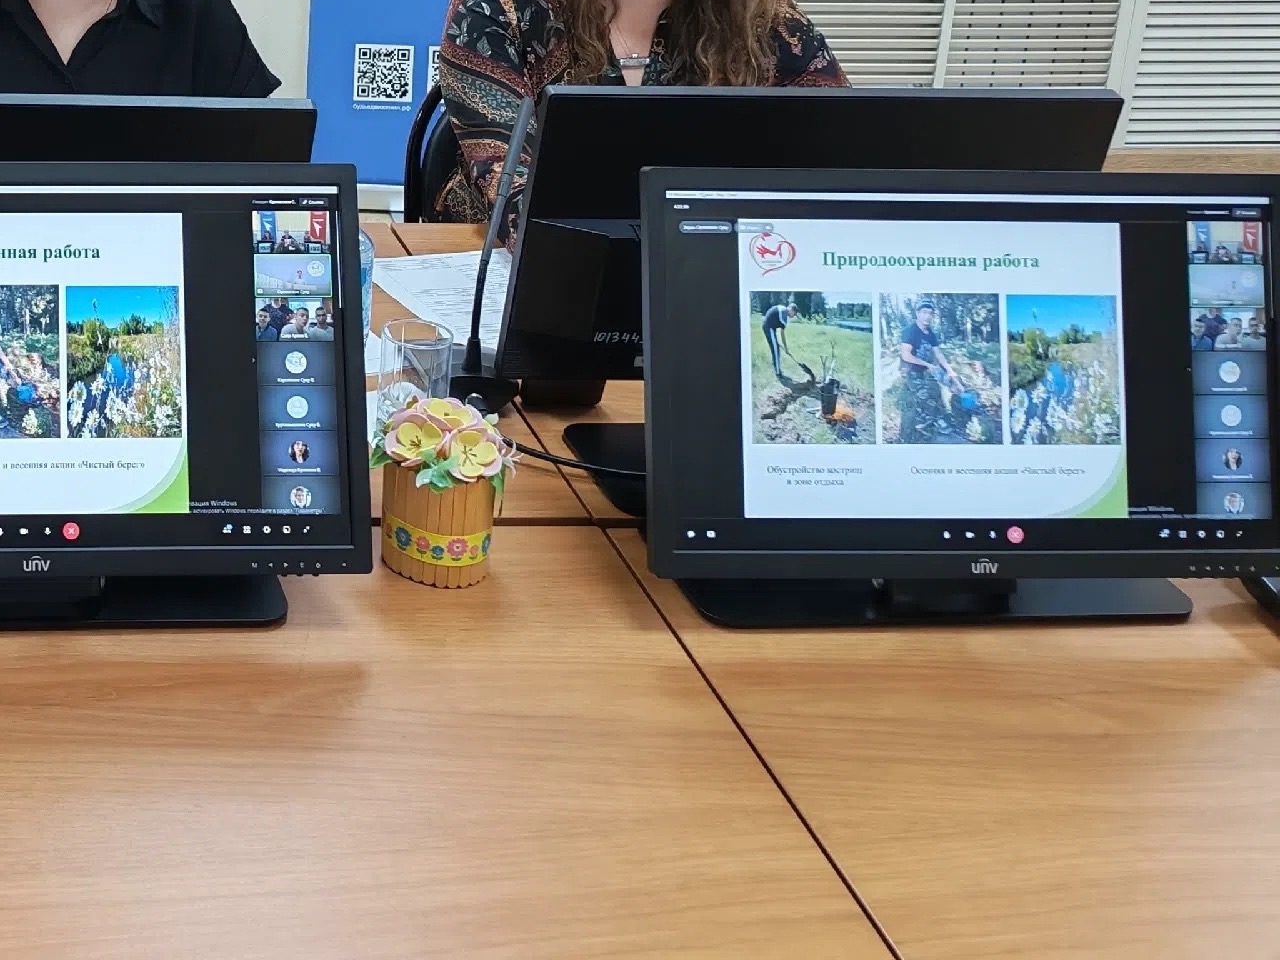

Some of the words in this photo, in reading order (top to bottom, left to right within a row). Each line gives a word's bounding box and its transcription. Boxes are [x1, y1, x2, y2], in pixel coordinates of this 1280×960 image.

[43, 244, 100, 262] работа
[822, 252, 977, 270] Природоохранная
[982, 253, 1040, 271] работа
[593, 331, 644, 343] 101344
[767, 465, 825, 476] Обустройство
